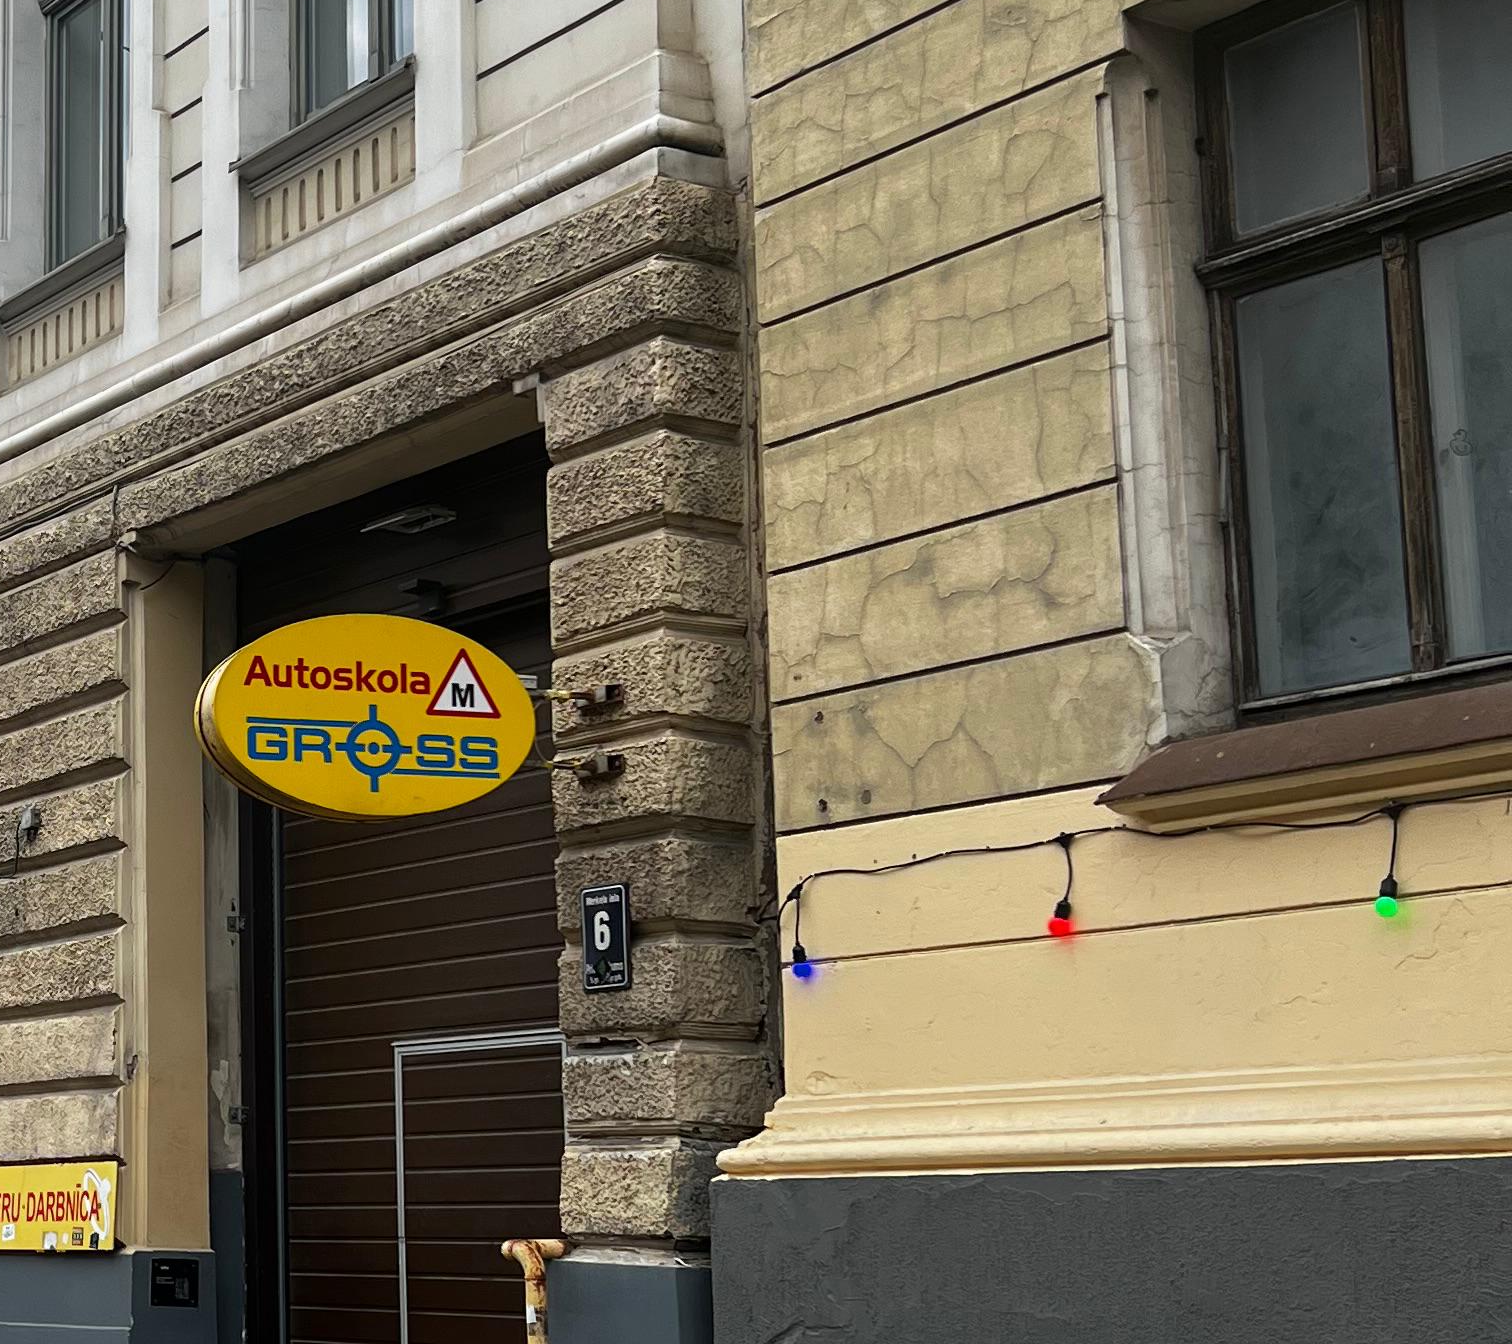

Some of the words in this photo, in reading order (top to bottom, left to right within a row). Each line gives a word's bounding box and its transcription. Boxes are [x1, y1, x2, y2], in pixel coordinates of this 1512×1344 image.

[243, 655, 431, 695] Autoskola
[451, 683, 475, 708] M
[246, 716, 499, 779] GROSS
[593, 910, 611, 951] 6
[26, 1183, 100, 1223] DARBNĪCA
